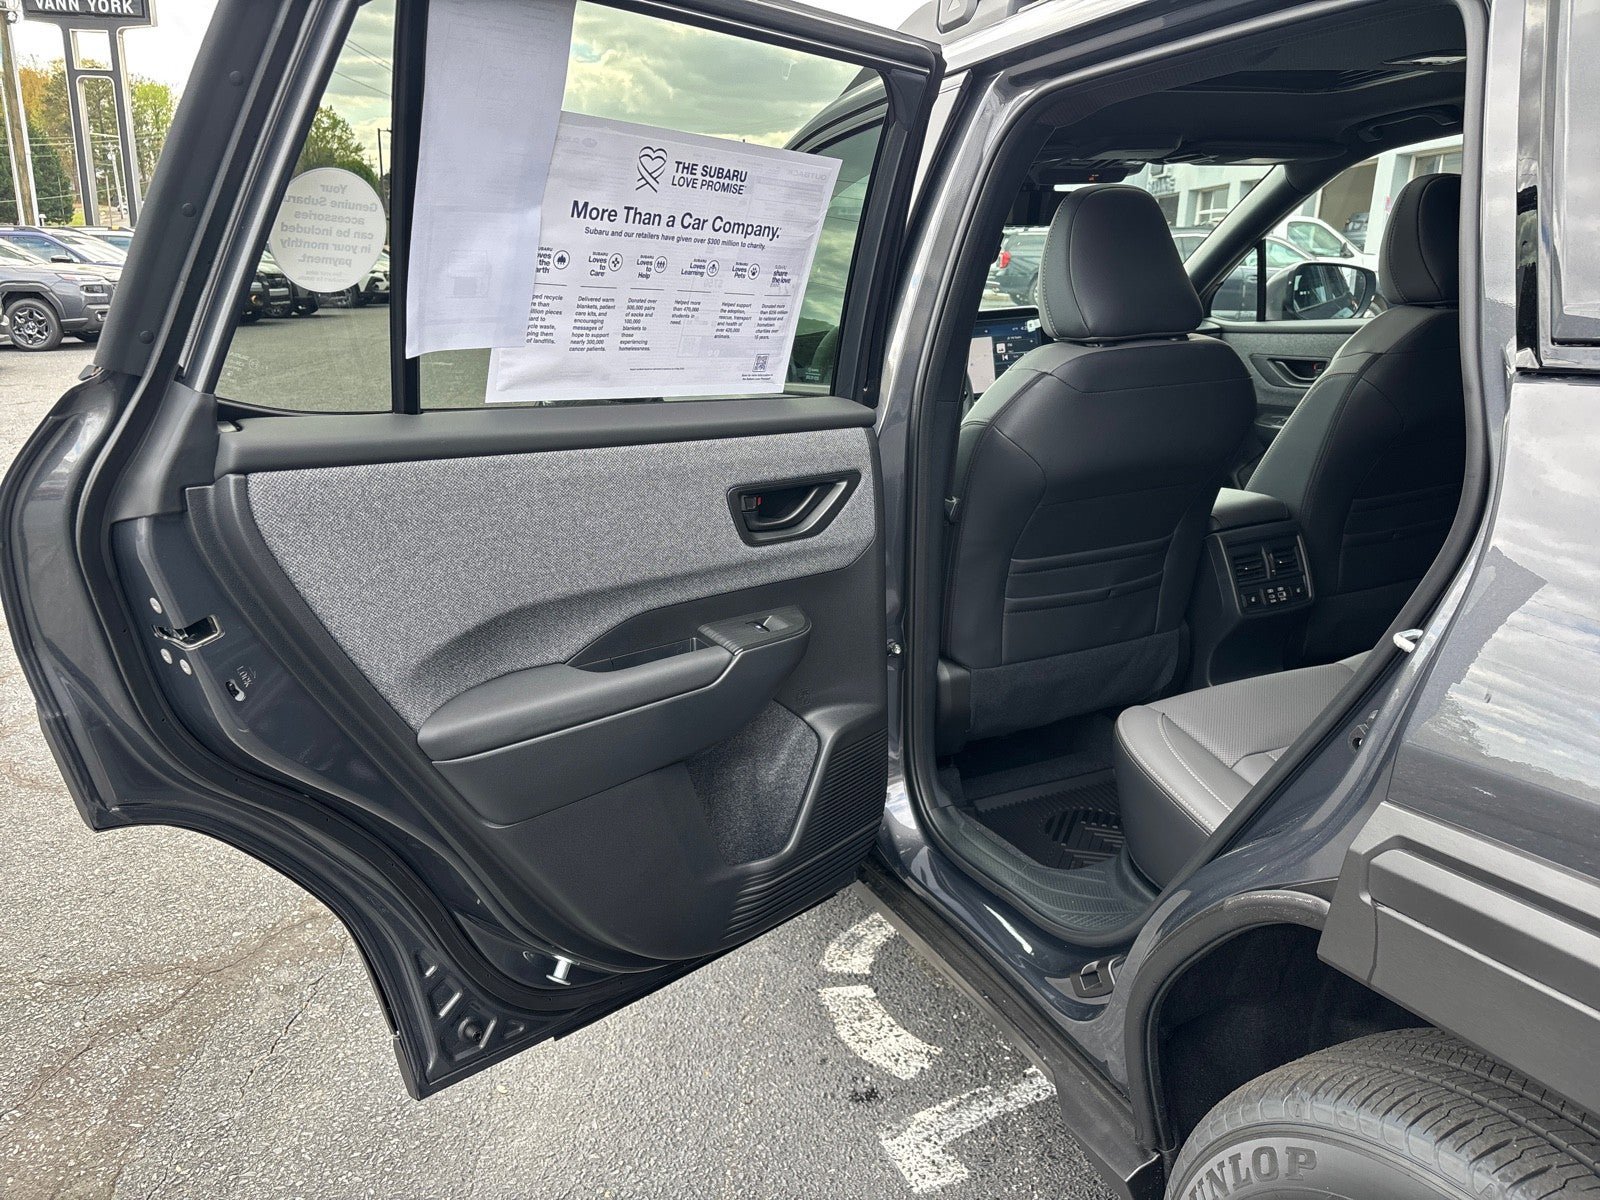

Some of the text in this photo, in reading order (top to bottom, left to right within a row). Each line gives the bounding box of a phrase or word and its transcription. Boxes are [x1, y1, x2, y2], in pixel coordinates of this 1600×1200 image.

[35, 0, 134, 14] VANN YORK
[675, 160, 748, 183] THE SUBARU
[672, 175, 698, 189] LOVE
[570, 200, 780, 242] More Than a Car Company.
[584, 226, 610, 236] Subaru
[635, 232, 660, 240] retailers
[661, 233, 675, 241] have
[676, 234, 692, 244] given
[707, 237, 721, 246] $300
[721, 238, 739, 247] million
[747, 242, 766, 250] charity.
[588, 256, 607, 264] Loves
[681, 269, 705, 277] Learning
[1188, 1146, 1317, 1200] UNLOP
